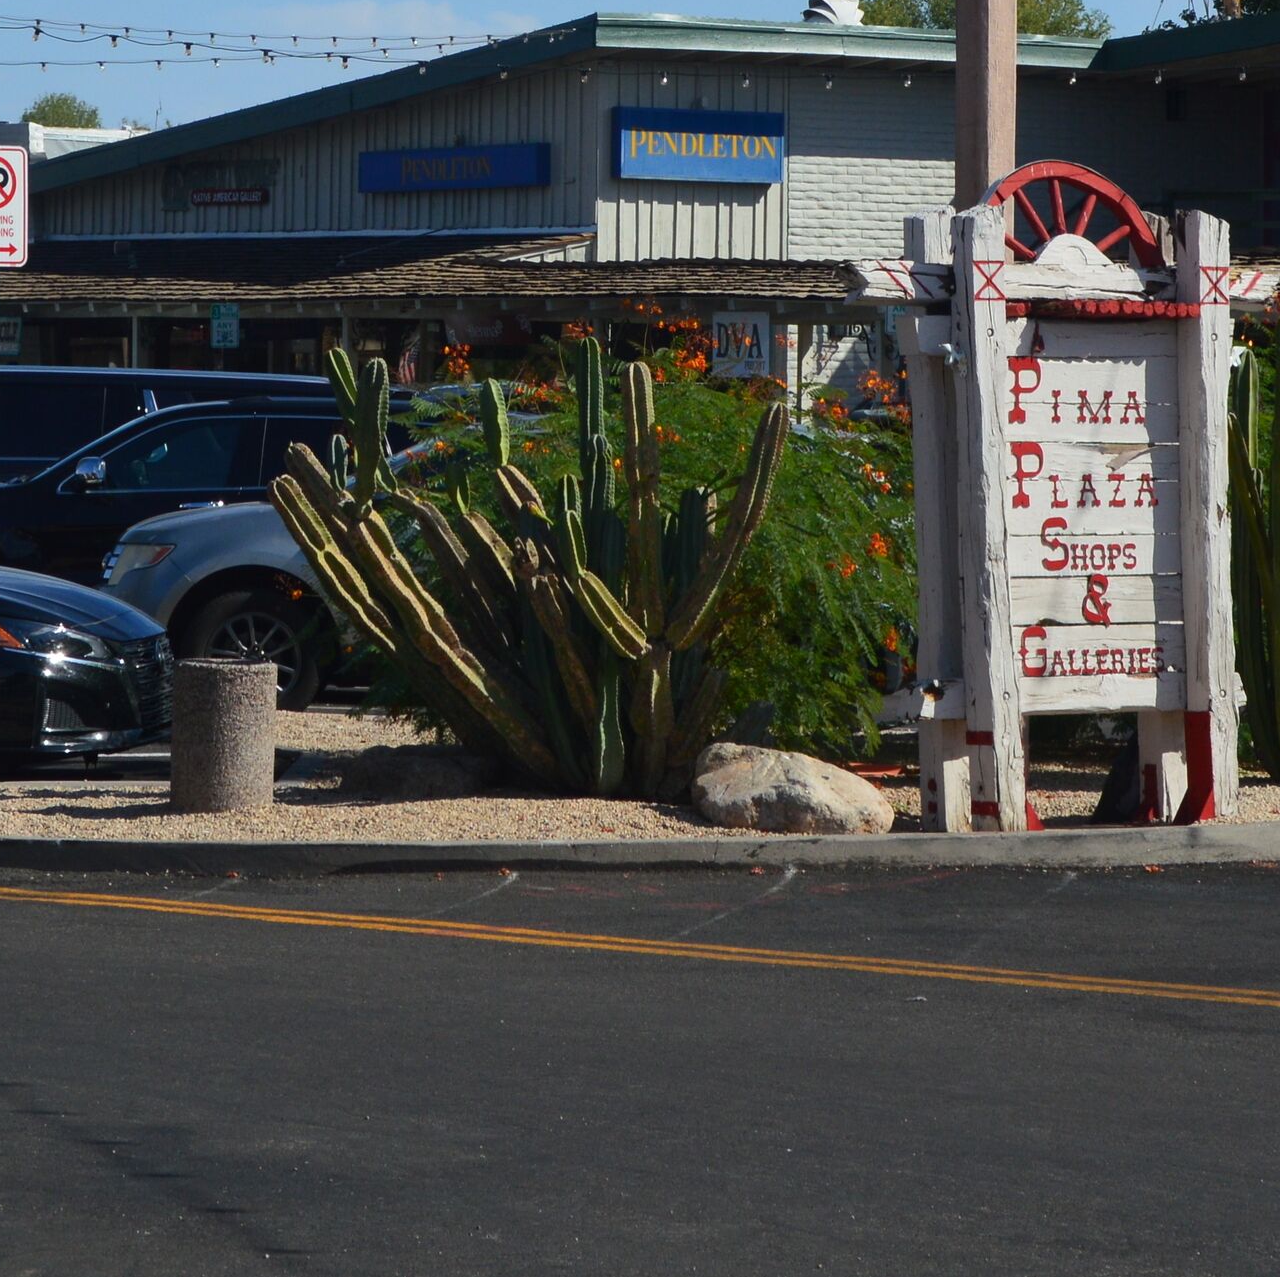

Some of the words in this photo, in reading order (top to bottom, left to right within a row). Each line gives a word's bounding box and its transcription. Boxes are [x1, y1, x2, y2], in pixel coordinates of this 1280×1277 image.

[629, 126, 776, 160] PENDLETON
[402, 155, 492, 185] PENDLETON
[1007, 356, 1145, 424] PIMA
[1010, 441, 1159, 509] PLAZA
[1040, 517, 1137, 572] SHOPS
[1081, 574, 1111, 627] &
[1018, 626, 1165, 678] GALLERIES
